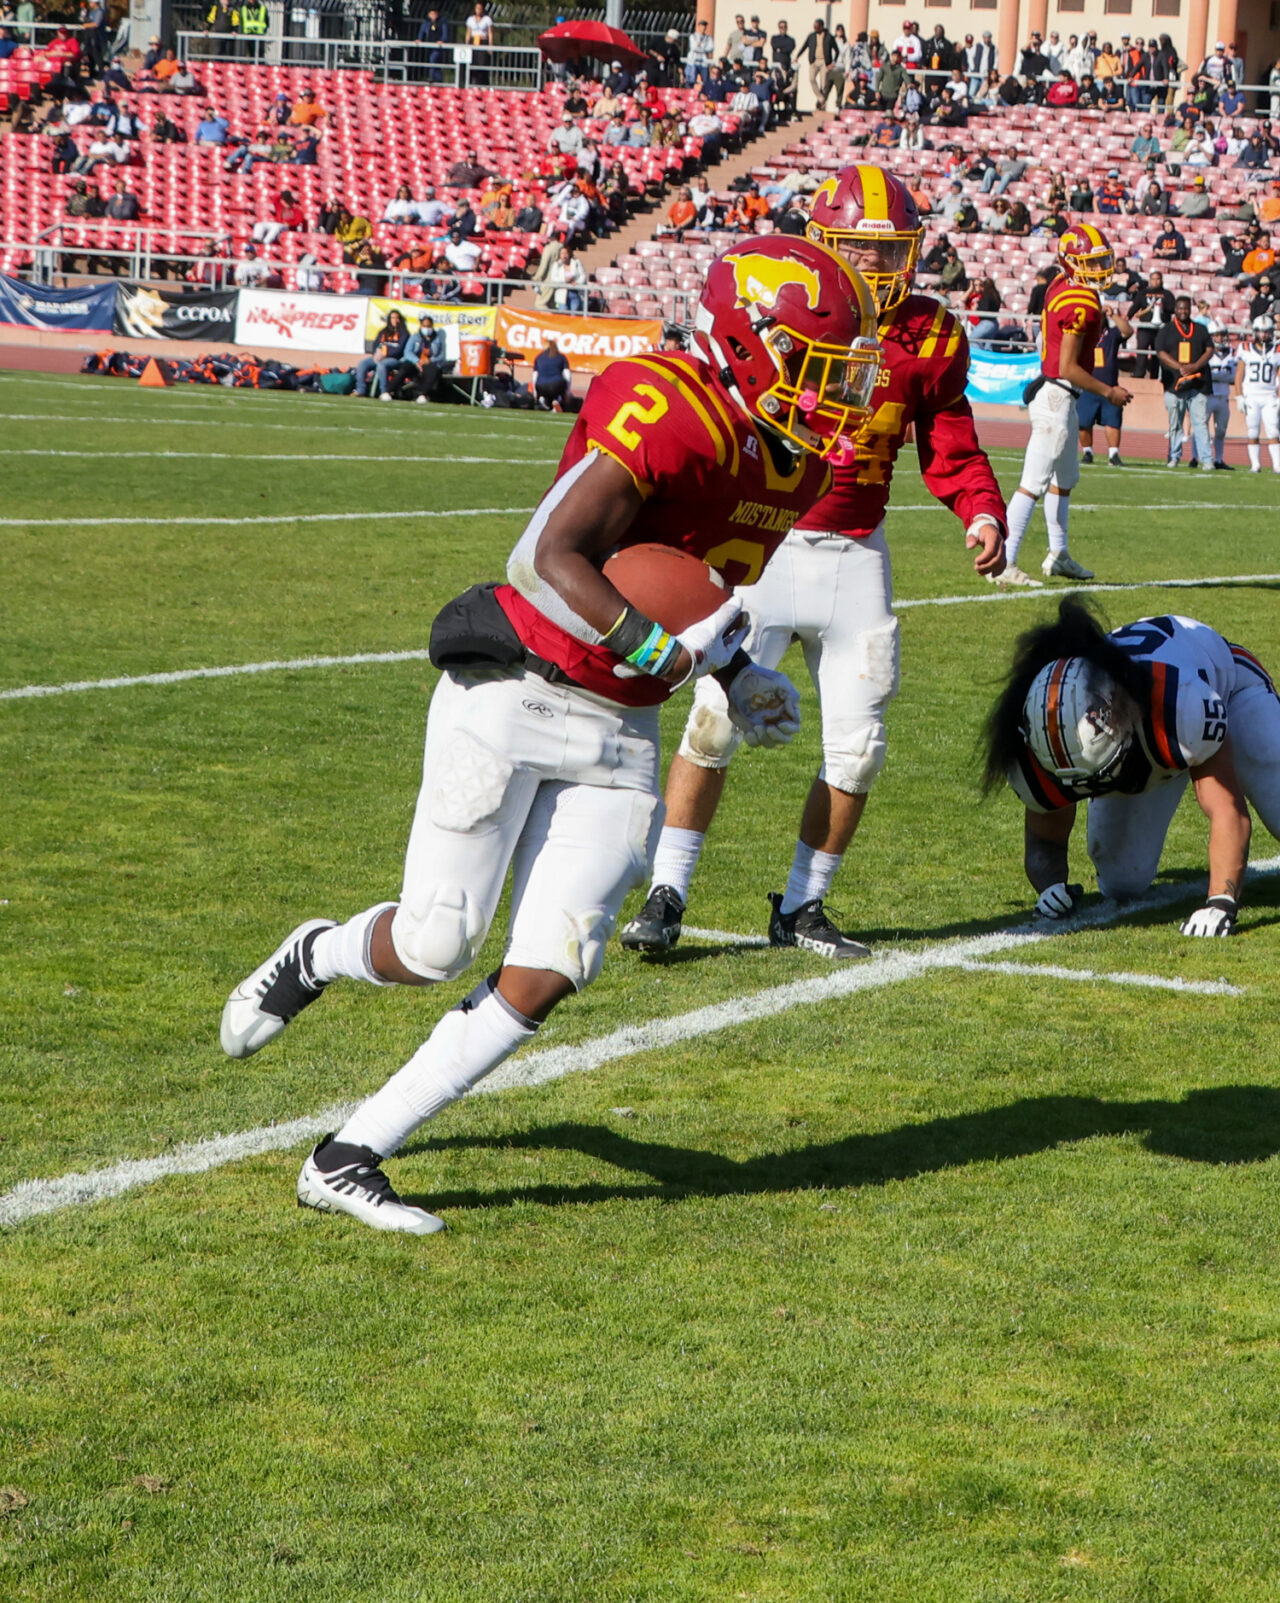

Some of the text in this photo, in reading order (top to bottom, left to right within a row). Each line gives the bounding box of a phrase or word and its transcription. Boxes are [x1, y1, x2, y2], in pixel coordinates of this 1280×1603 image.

[176, 305, 232, 323] CCPOA
[1072, 306, 1087, 330] 3
[506, 324, 652, 358] GATORADE
[1249, 362, 1273, 384] 30
[606, 383, 669, 452] 2
[728, 500, 799, 533] MUSTANGS
[1202, 698, 1227, 743] 55
